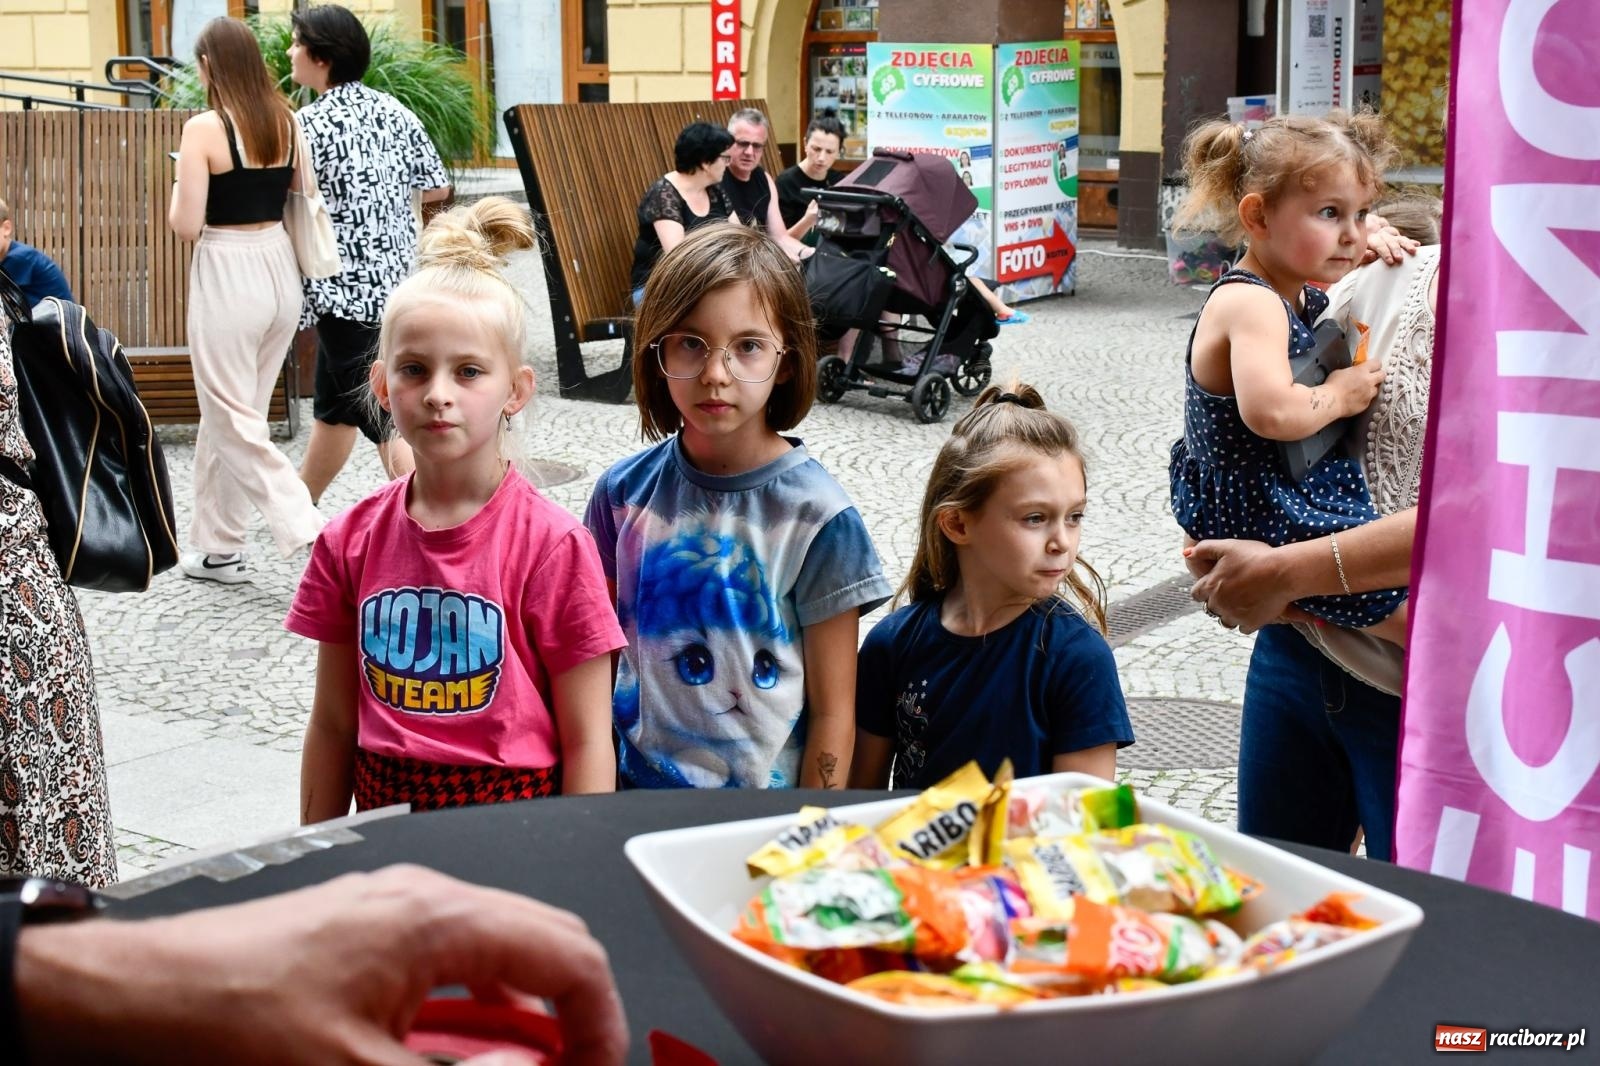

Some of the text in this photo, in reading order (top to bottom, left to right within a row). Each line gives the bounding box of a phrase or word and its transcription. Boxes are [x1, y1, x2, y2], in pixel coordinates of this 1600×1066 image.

[715, 0, 736, 101] GRA
[891, 51, 973, 70] ZDJĘCIA
[913, 73, 985, 88] CYFROWE
[1030, 69, 1075, 84] CYFROWE
[1004, 160, 1051, 173] LEGITYMACJI
[1004, 201, 1076, 218] PRZEGRYWANIE KASET
[1004, 218, 1043, 232] VHS DVD
[1000, 245, 1045, 275] FOTO
[365, 592, 499, 675] WOJAN
[385, 675, 469, 710] TEAM
